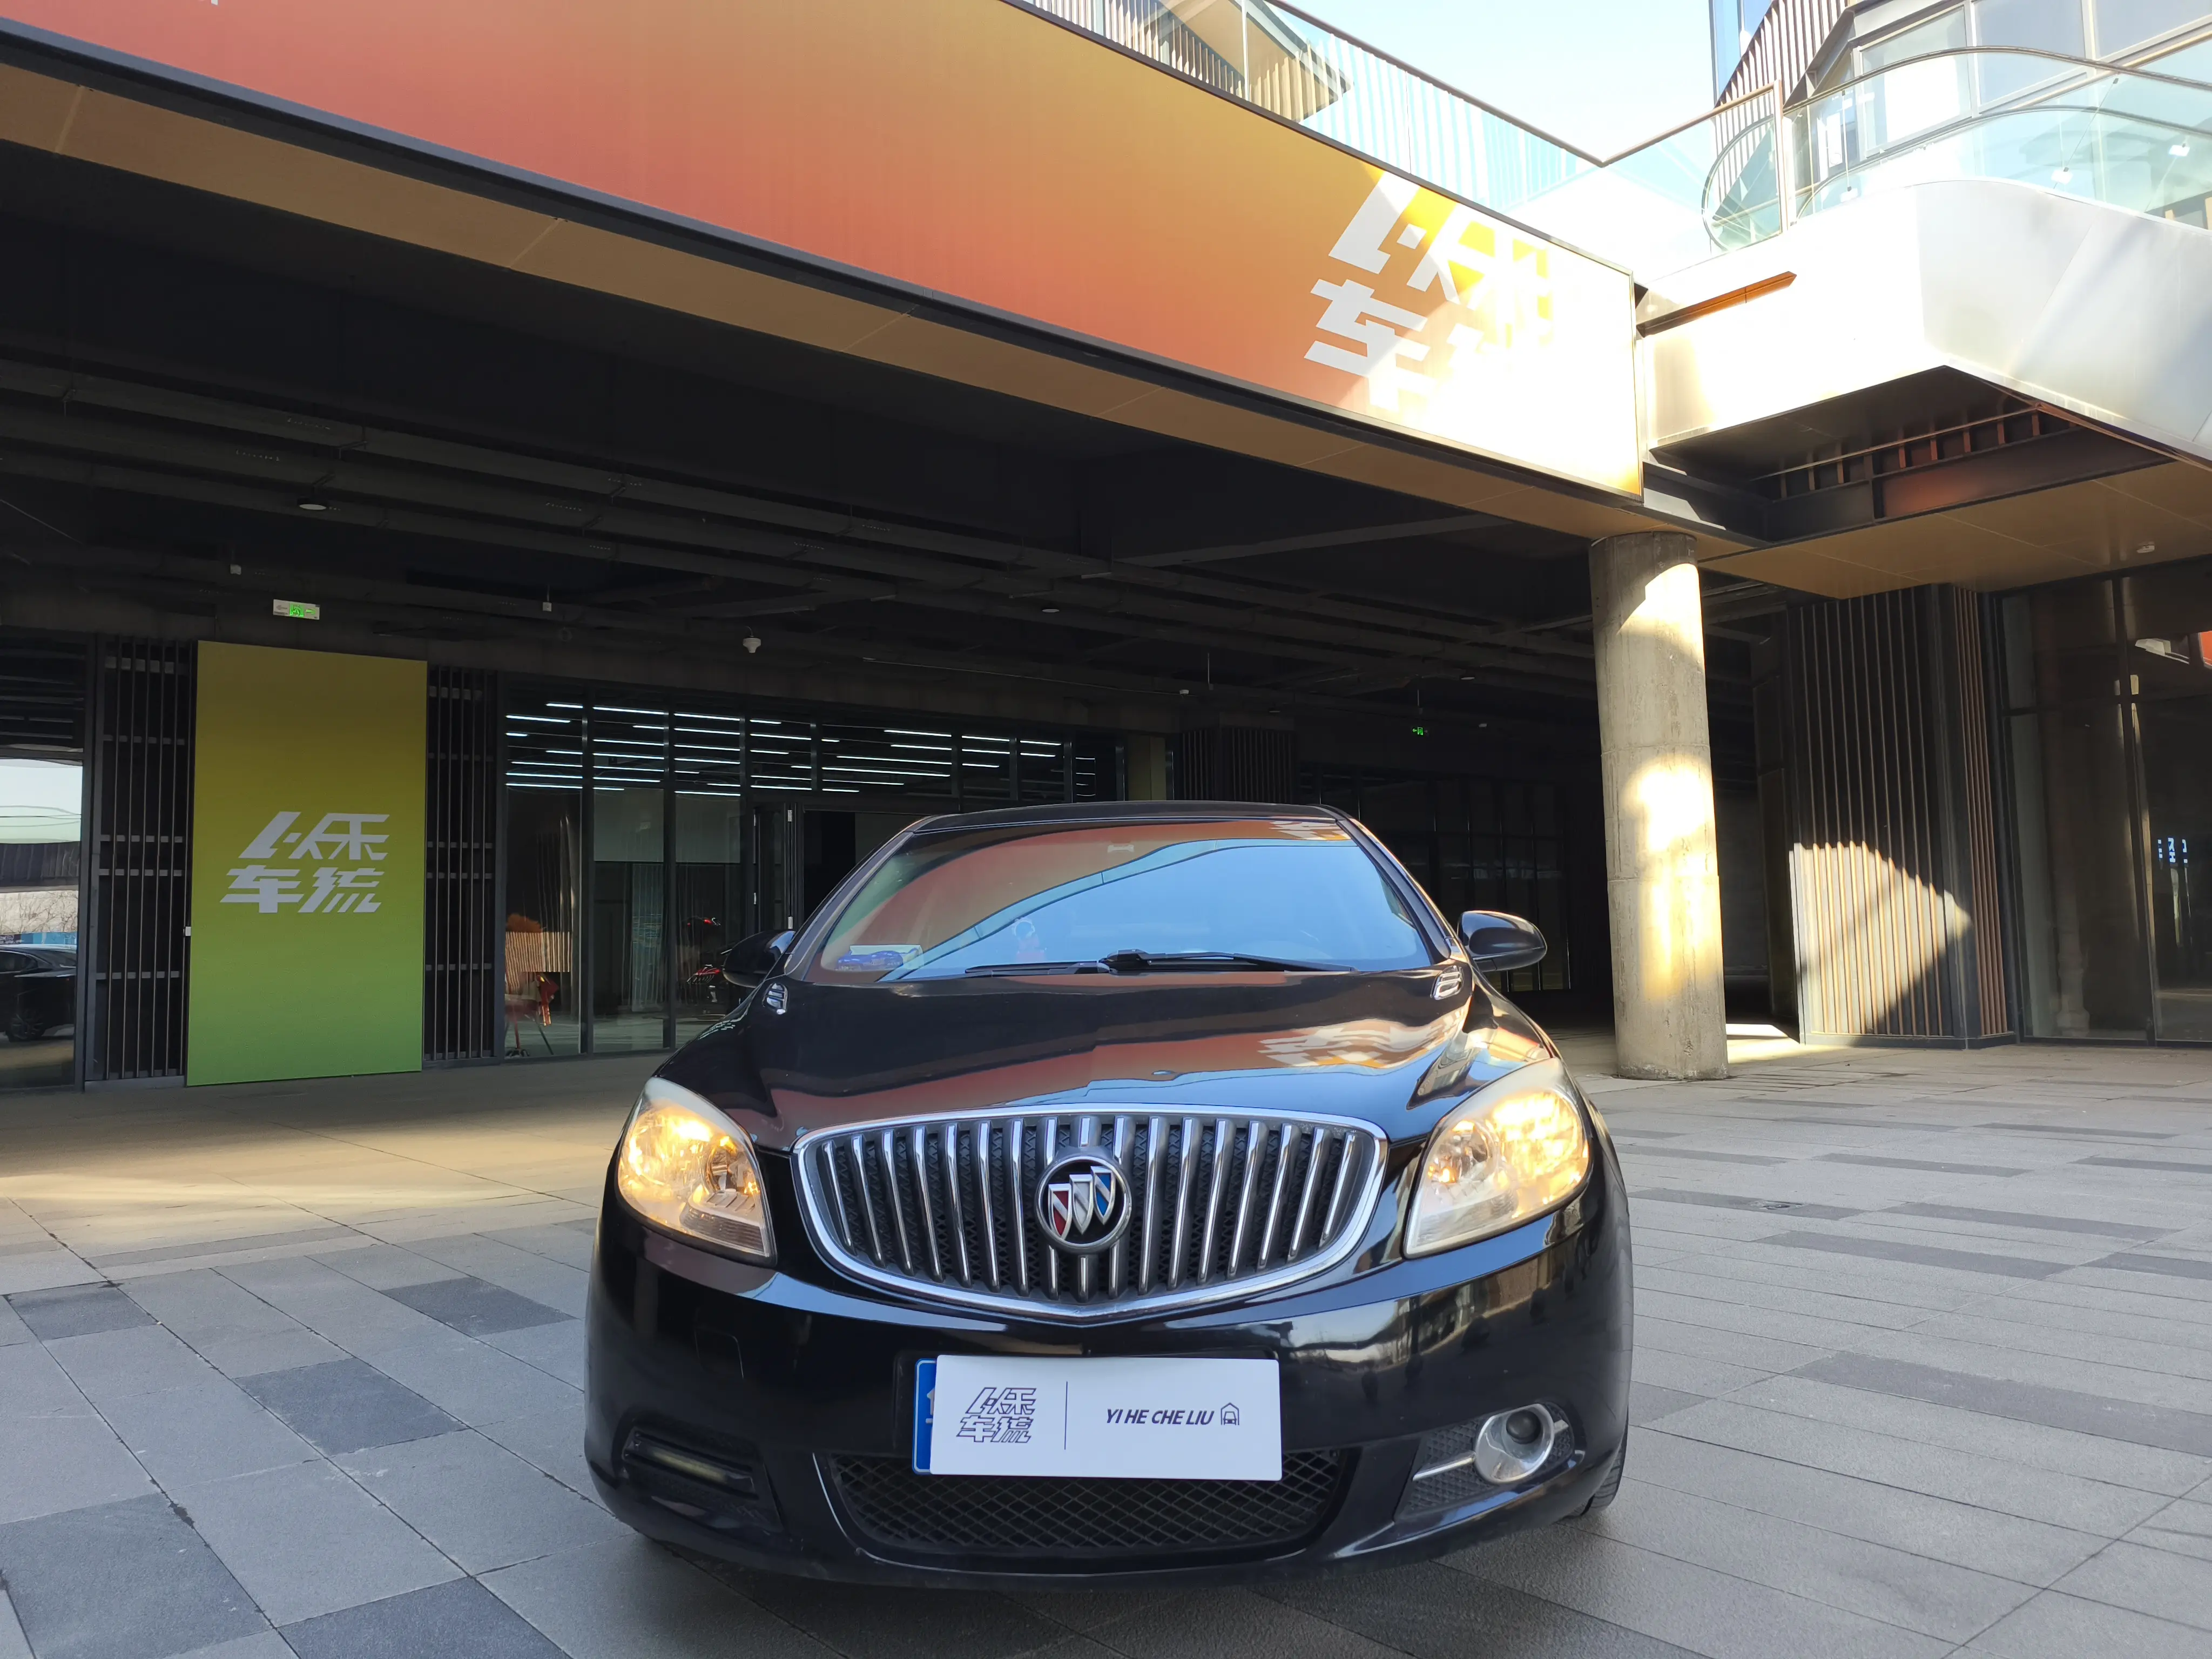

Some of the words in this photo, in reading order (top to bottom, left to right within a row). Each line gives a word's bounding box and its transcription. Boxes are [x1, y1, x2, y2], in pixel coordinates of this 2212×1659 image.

[220, 865, 385, 913] 车流
[956, 1414, 1034, 1444] 车流
[1107, 1408, 1123, 1424] YI
[1124, 1409, 1150, 1424] HE
[1151, 1410, 1185, 1425] CHE
[1186, 1411, 1215, 1425] LIU
